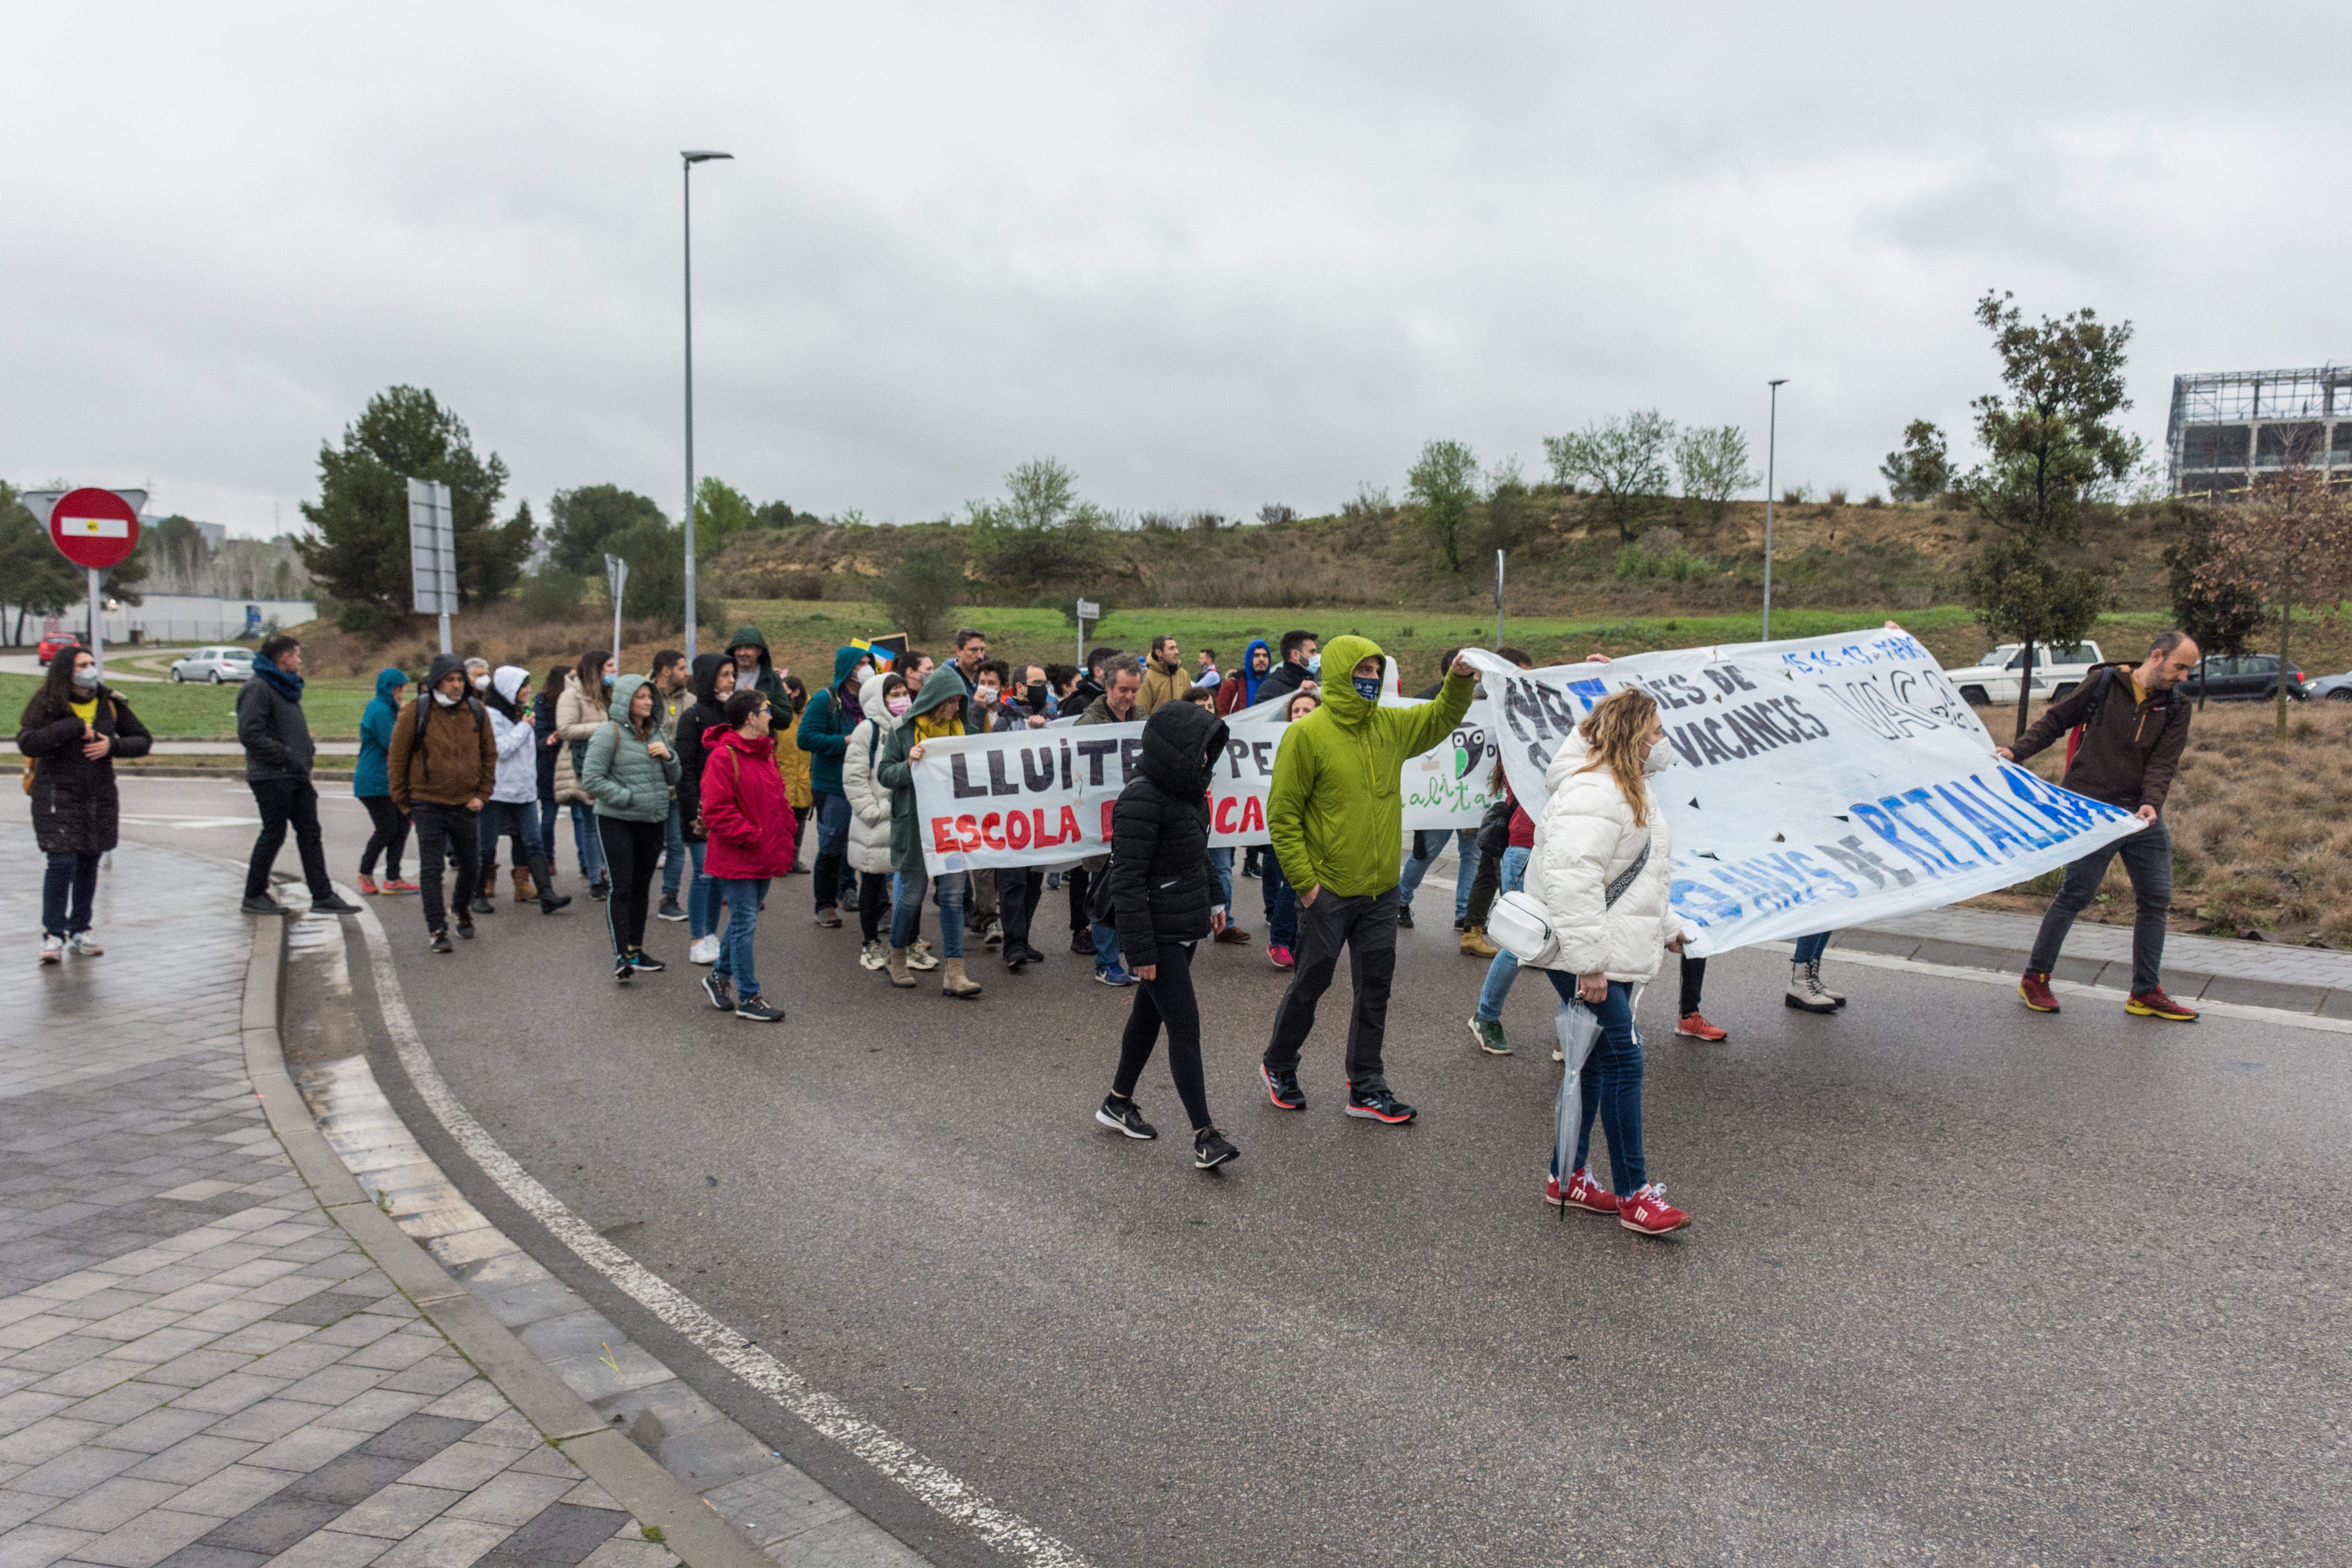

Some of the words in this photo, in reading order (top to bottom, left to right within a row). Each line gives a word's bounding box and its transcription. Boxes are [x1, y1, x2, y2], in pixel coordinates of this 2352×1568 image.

[1505, 676, 1575, 742] NO
[1702, 664, 1757, 696] DE
[1662, 695, 1830, 768] VACANCES
[1225, 739, 1273, 779] PE
[1401, 774, 1503, 813] alita
[931, 805, 1082, 854] ESCOLA
[1708, 851, 1859, 918] ANYS
[1814, 835, 1918, 889] DE
